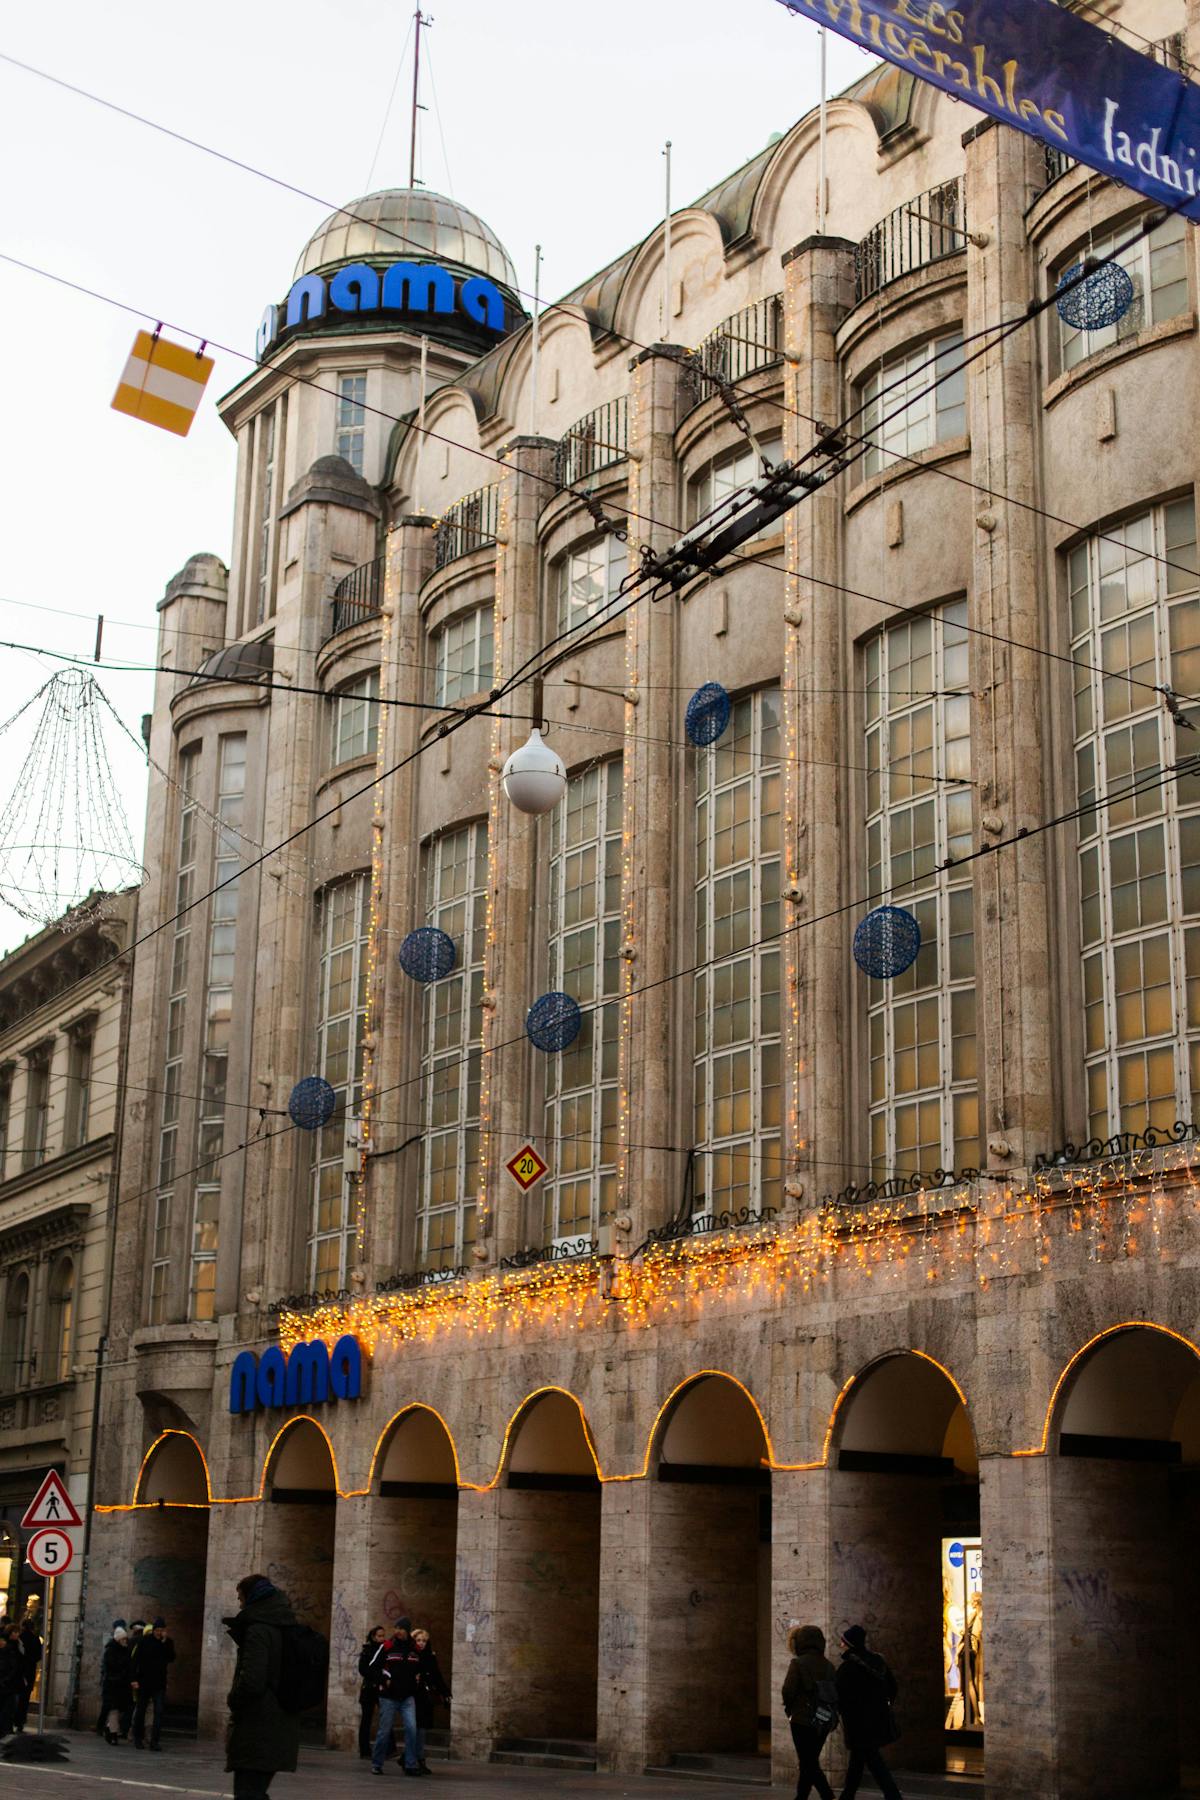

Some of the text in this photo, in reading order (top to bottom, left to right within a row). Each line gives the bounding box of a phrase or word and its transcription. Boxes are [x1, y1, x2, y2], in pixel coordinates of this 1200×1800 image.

[286, 261, 505, 332] nama
[520, 1158, 534, 1174] 20
[229, 1334, 362, 1415] nama
[44, 1541, 58, 1565] 5
